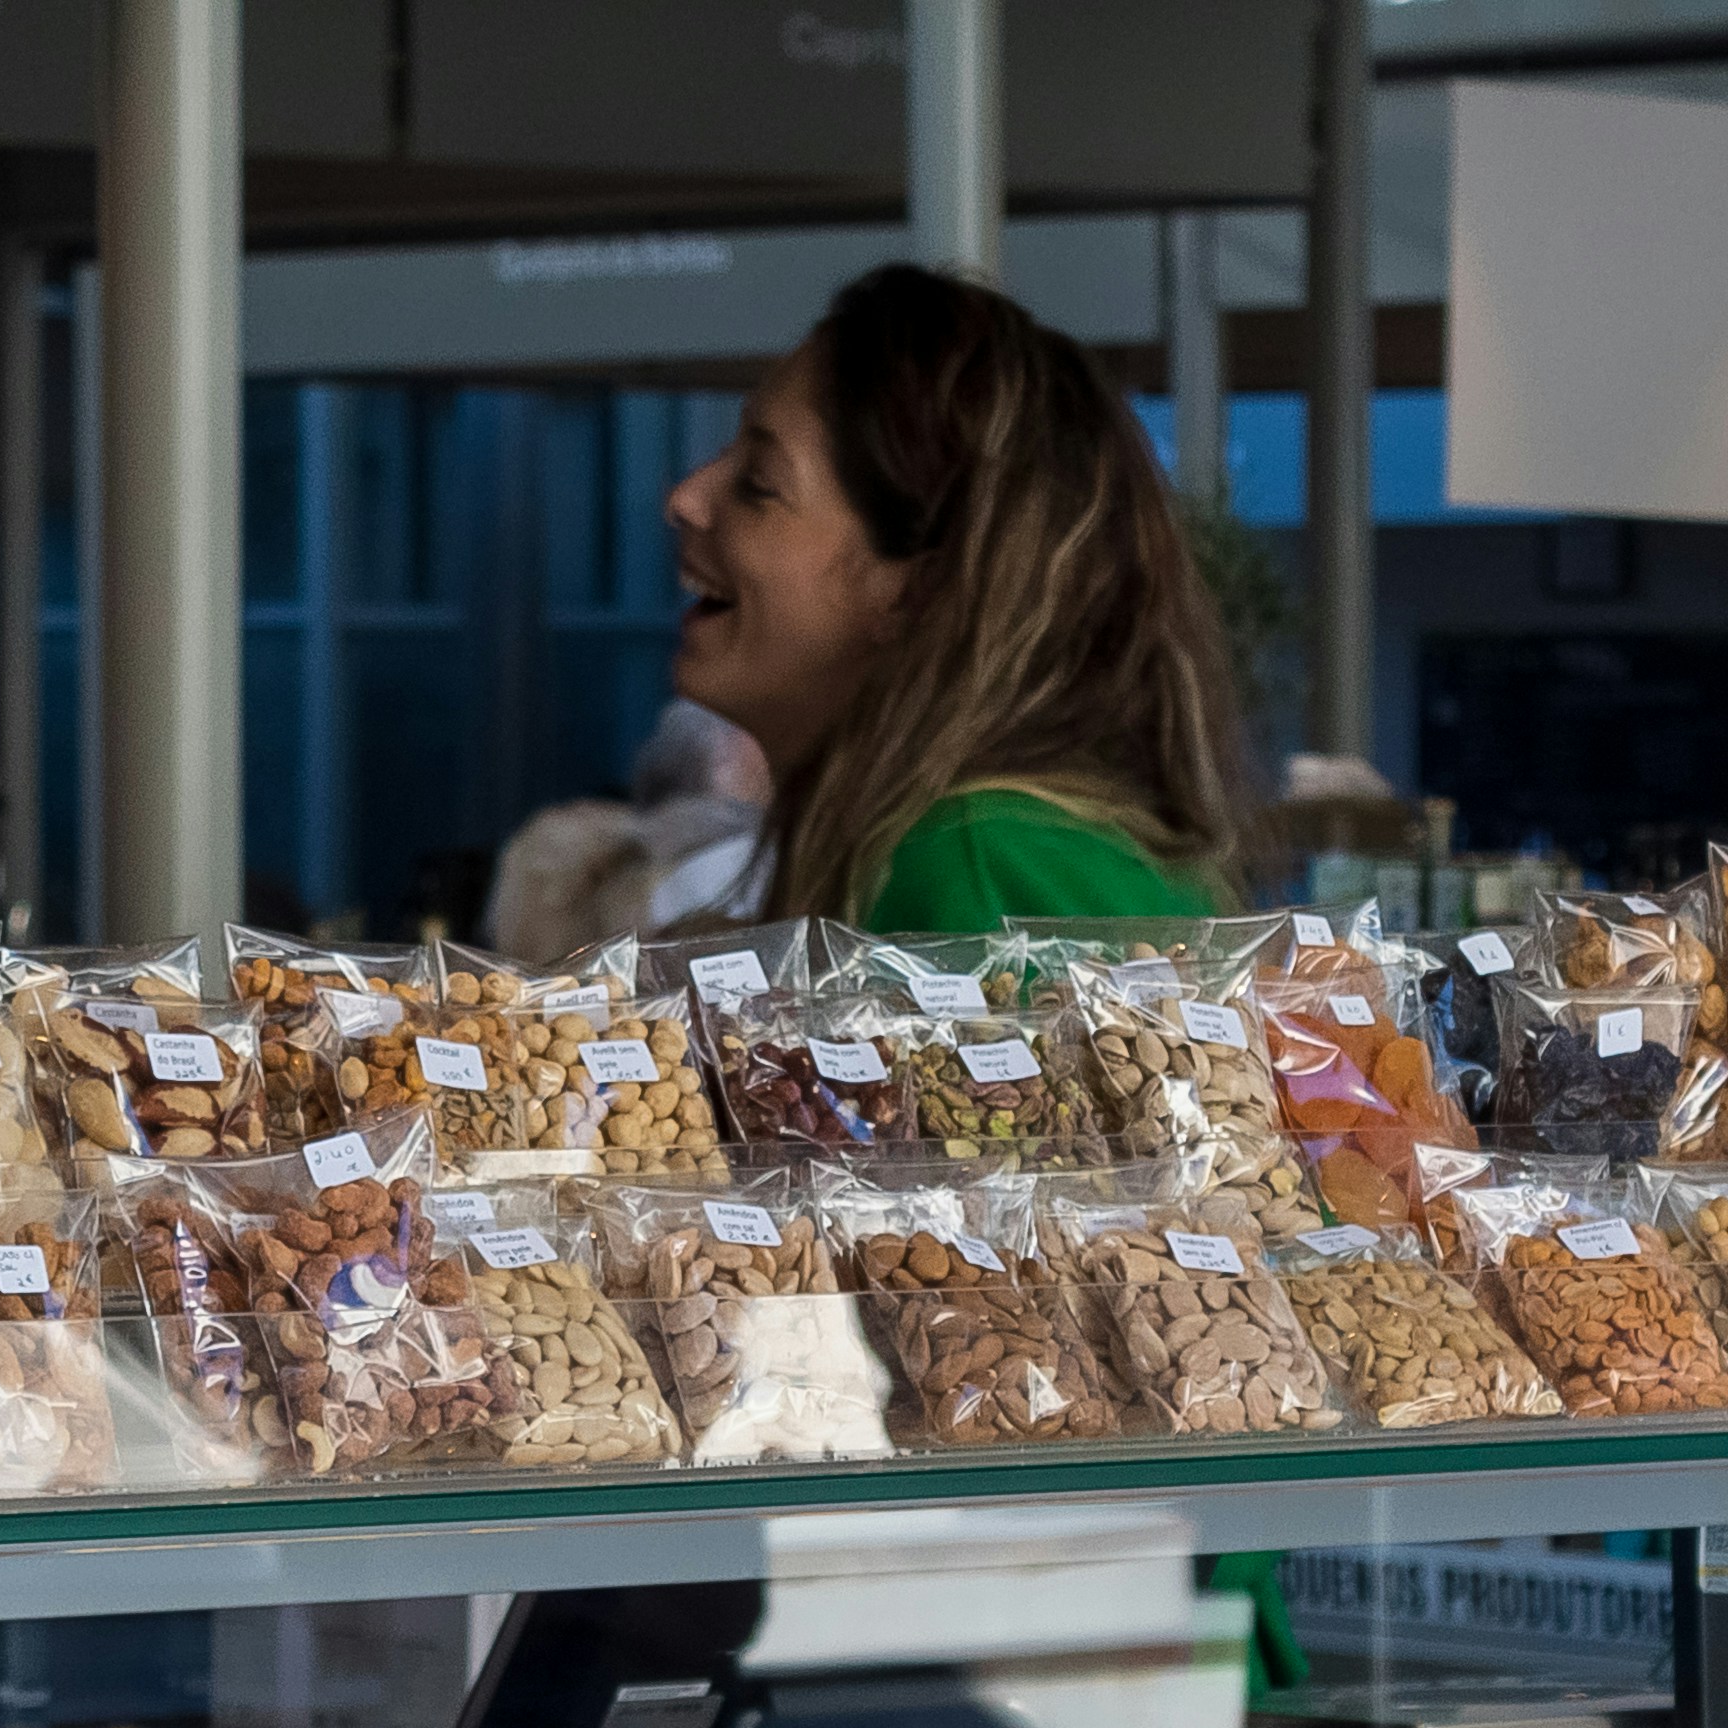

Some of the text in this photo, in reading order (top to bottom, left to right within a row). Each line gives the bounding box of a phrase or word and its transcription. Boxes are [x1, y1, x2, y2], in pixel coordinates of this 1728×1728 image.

[726, 960, 745, 969] com
[153, 1038, 196, 1051] Castanha
[426, 1042, 461, 1058] Cocktail
[591, 1044, 639, 1056] Avelã sem
[157, 1055, 196, 1067] do Brasil
[717, 1207, 758, 1221] Amêndoa
[722, 1222, 743, 1231] com
[482, 1233, 527, 1245] Amêndoa
